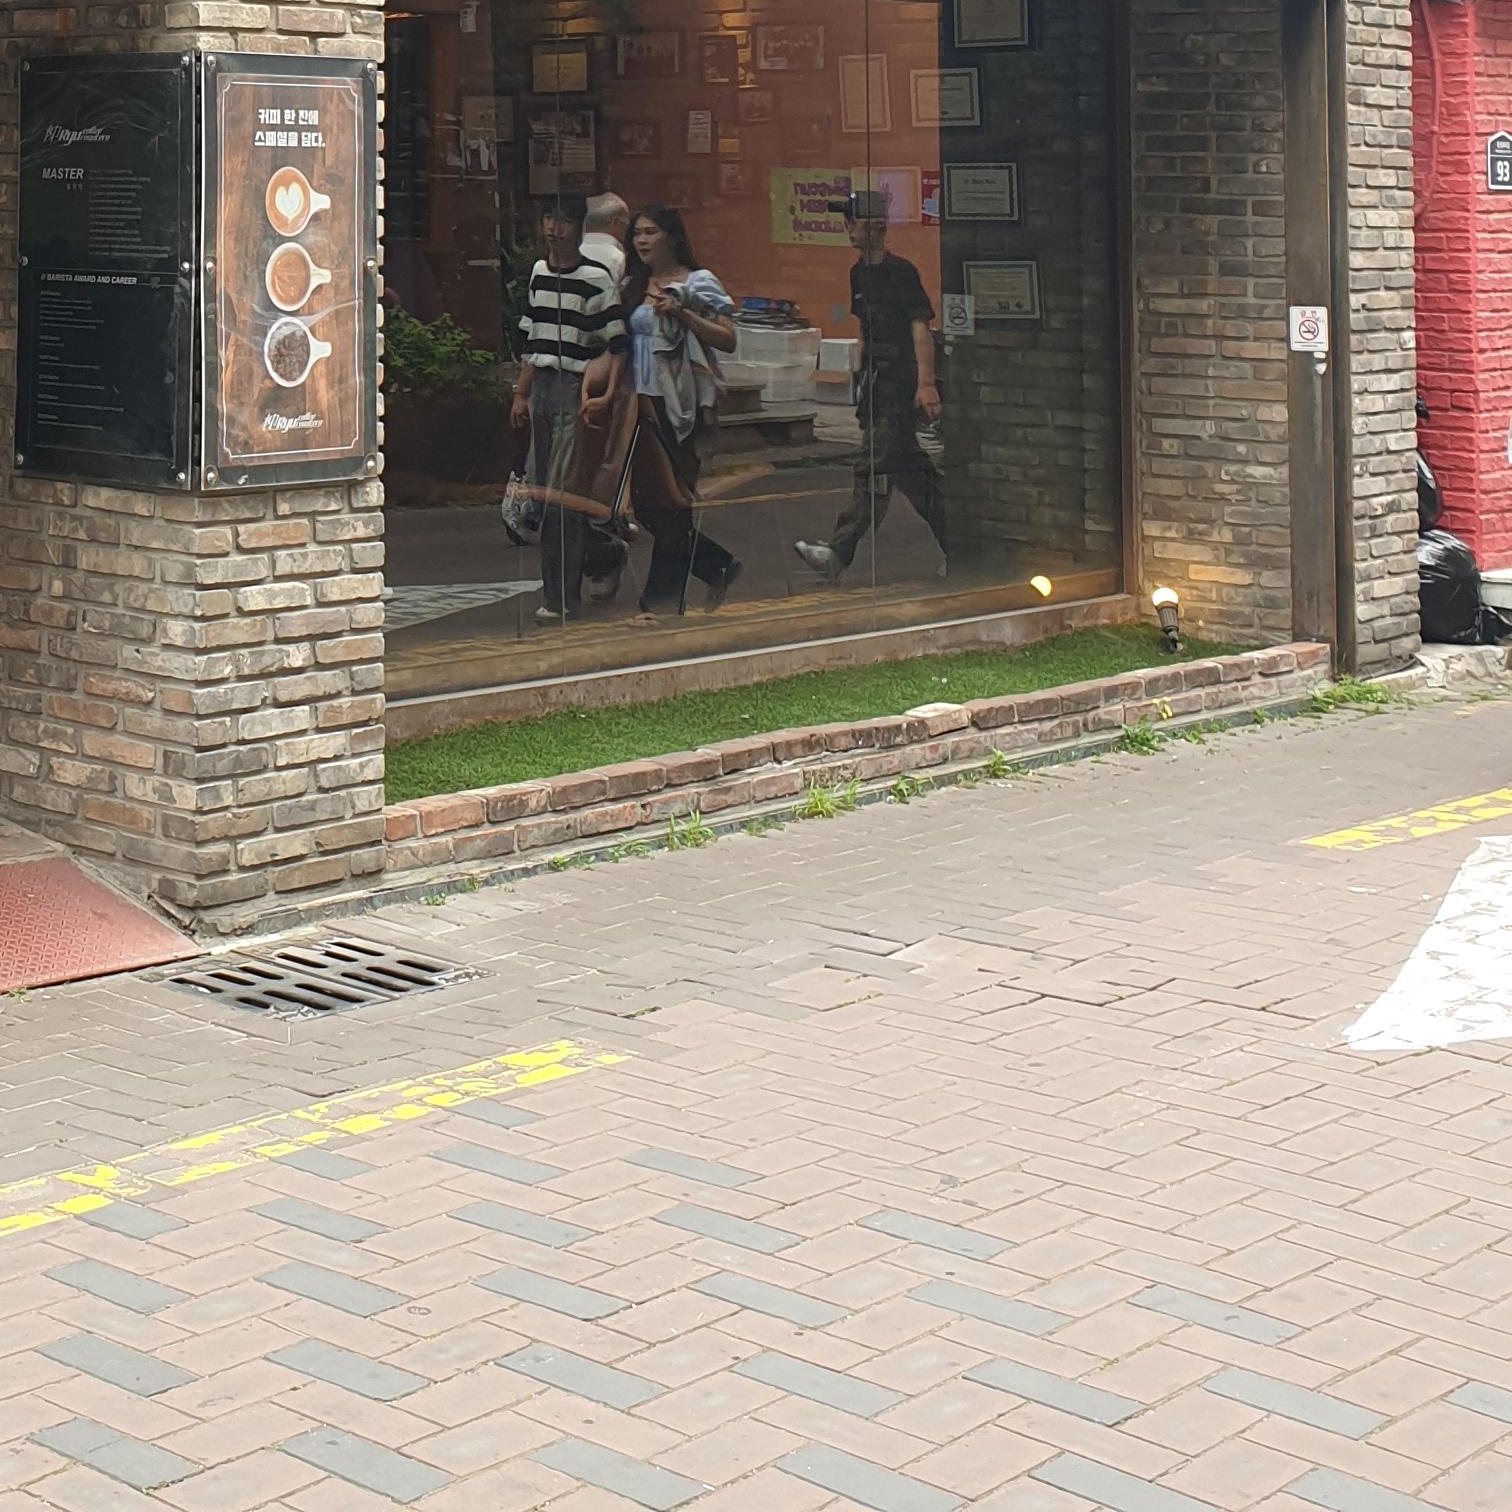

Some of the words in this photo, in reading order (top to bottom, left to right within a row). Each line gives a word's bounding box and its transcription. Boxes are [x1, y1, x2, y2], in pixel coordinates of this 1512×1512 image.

[258, 109, 281, 124] 커피
[284, 109, 296, 125] 한
[42, 168, 84, 180] MASTER
[1497, 160, 1510, 182] 93
[47, 273, 73, 281] BARISTA
[74, 274, 96, 283] AWARD
[97, 275, 110, 284] AND
[111, 276, 137, 285] CAREER
